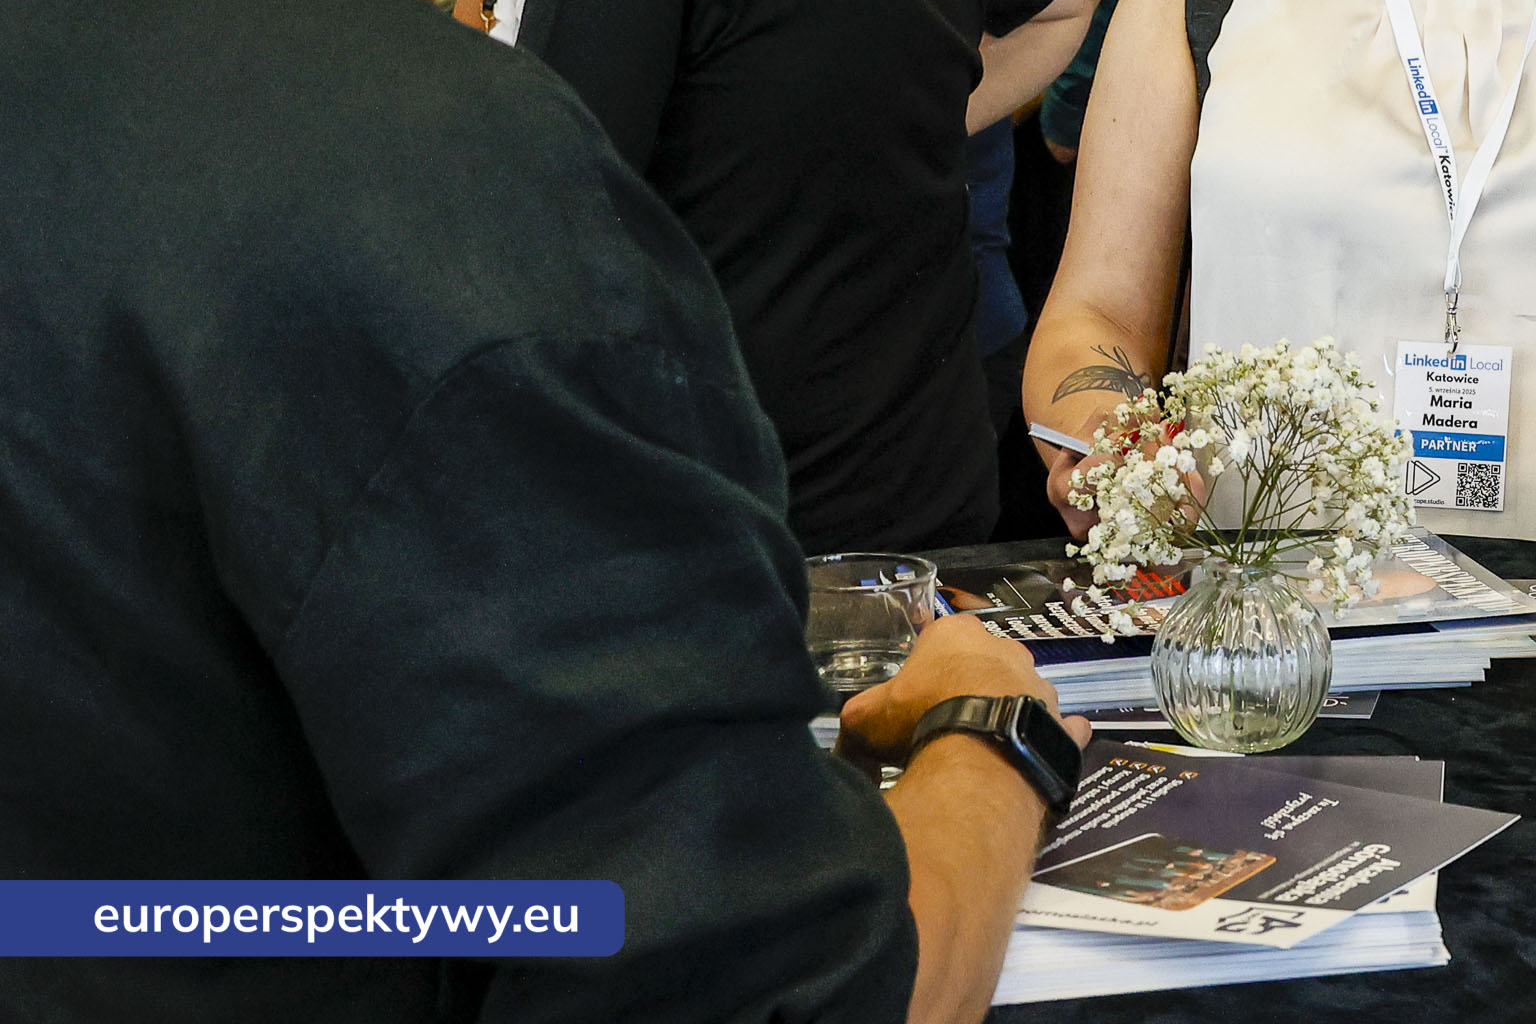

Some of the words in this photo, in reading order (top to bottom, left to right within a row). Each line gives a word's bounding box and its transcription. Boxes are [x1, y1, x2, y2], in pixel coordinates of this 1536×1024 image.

[1426, 117, 1448, 150] Local
[1470, 357, 1503, 371] Local
[1426, 371, 1479, 384] Katowice
[1430, 395, 1473, 409] Maria
[1422, 414, 1478, 429] Madera
[1421, 439, 1477, 452] PARTNER
